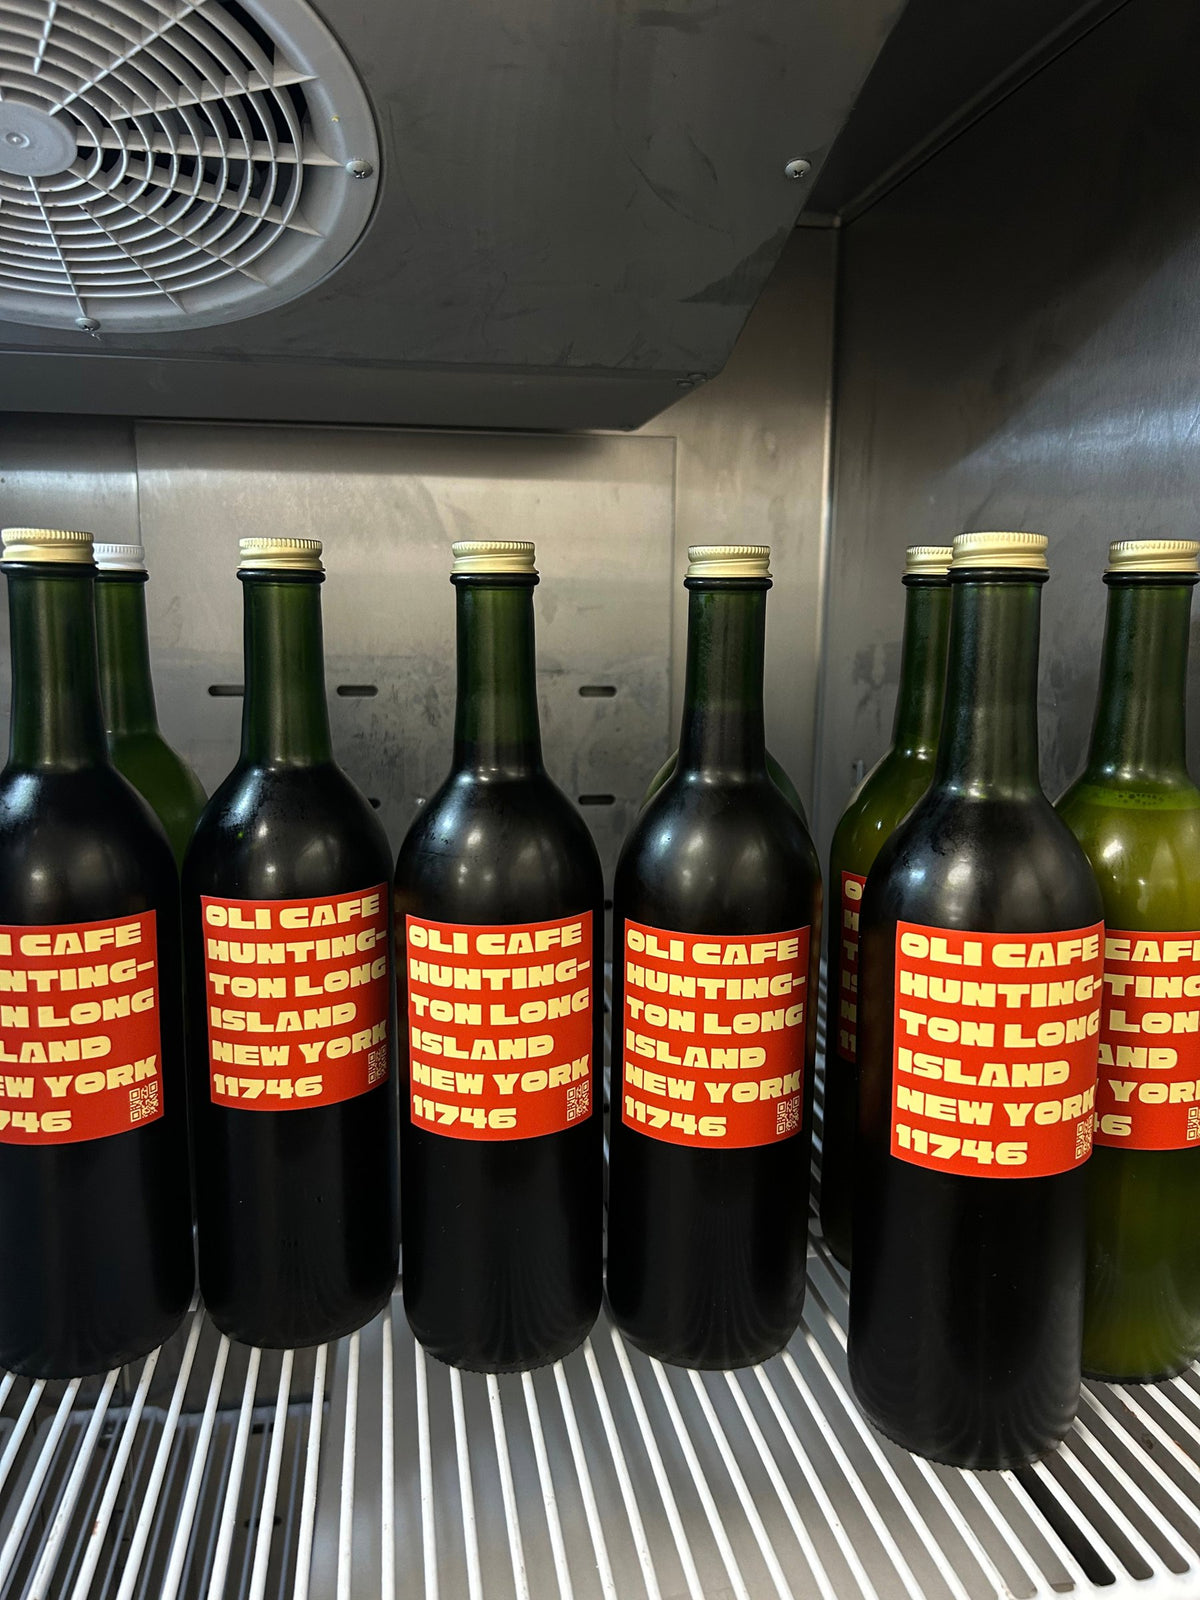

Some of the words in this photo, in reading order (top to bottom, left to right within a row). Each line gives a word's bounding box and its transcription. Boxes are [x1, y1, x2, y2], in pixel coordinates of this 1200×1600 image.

[206, 904, 271, 930] OLI
[279, 893, 380, 929] CAFE
[20, 922, 142, 957] CAFE
[207, 927, 387, 964] HUNTING-
[409, 925, 468, 955] OLI
[476, 922, 582, 956] CAFE
[627, 928, 685, 961] OLI
[692, 937, 798, 966] CAFE
[901, 932, 982, 967] OLI
[991, 934, 1099, 968] CAFE
[0, 958, 155, 992] NTING-
[209, 972, 287, 999] TON
[294, 955, 386, 998] LONG
[410, 958, 591, 991] HUNTING-
[627, 961, 806, 1000] HUNTING-
[900, 970, 1102, 1008] HUNTING-
[1104, 973, 1200, 998] TING
[38, 988, 154, 1028] LONG
[210, 1001, 357, 1033] ISLAND
[411, 993, 482, 1026] TON
[490, 987, 590, 1026] LONG
[627, 994, 695, 1034] TON
[704, 1003, 803, 1035] LONG
[1109, 1010, 1200, 1034] LON
[212, 1039, 290, 1066] NEW
[298, 1019, 387, 1064] YORK
[411, 1026, 554, 1061] ISLAND
[899, 1009, 995, 1048] TON
[1003, 1008, 1100, 1048] LONG
[0, 1036, 112, 1063] LAND
[626, 1028, 767, 1069] ISLAND
[898, 1047, 1070, 1088] ISLAND
[1098, 1044, 1178, 1069] AND
[43, 1055, 157, 1098] YORK
[213, 1073, 323, 1100] 11746
[412, 1060, 484, 1095] NEW
[492, 1054, 589, 1096] YORK
[625, 1062, 695, 1101] NEW
[704, 1070, 801, 1104] YORK
[1108, 1080, 1200, 1104] YOR
[413, 1094, 517, 1130] 11746
[625, 1095, 727, 1137] 11746
[896, 1085, 993, 1126] NEW
[896, 1124, 1028, 1166] 11746
